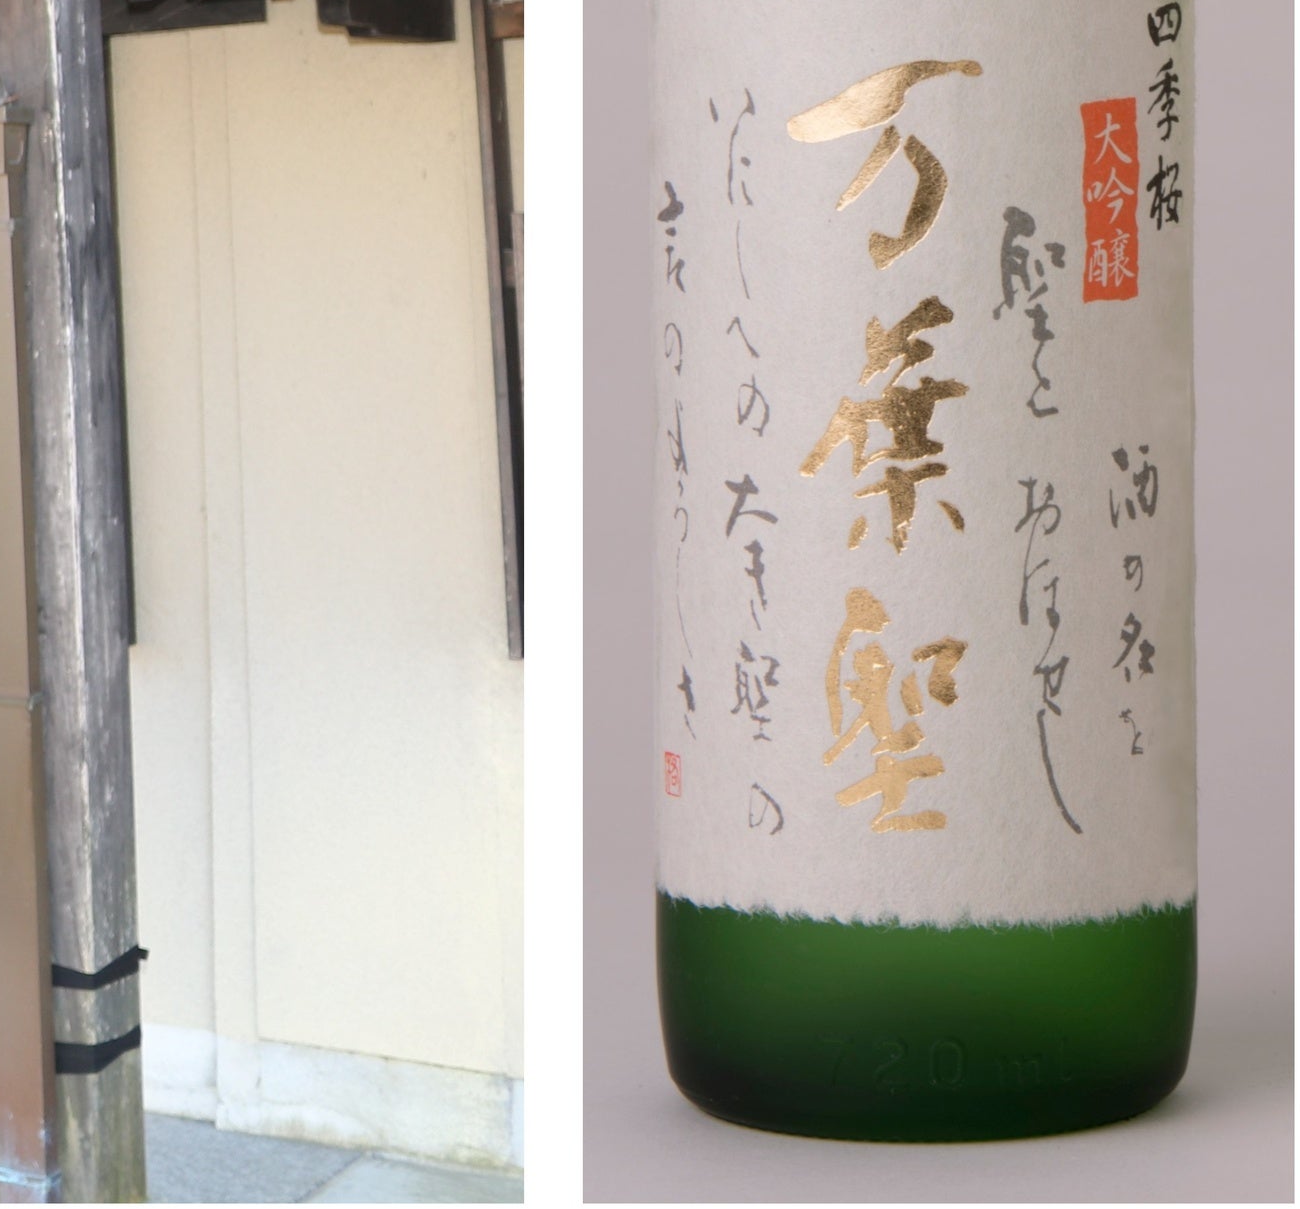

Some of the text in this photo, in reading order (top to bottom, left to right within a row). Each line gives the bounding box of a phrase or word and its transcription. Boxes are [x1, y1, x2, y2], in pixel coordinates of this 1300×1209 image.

[1086, 112, 1136, 289] 大吟醸
[1146, 1, 1184, 232] 四季桜
[785, 58, 985, 834] 万葉聖
[814, 1035, 966, 1088] 720
